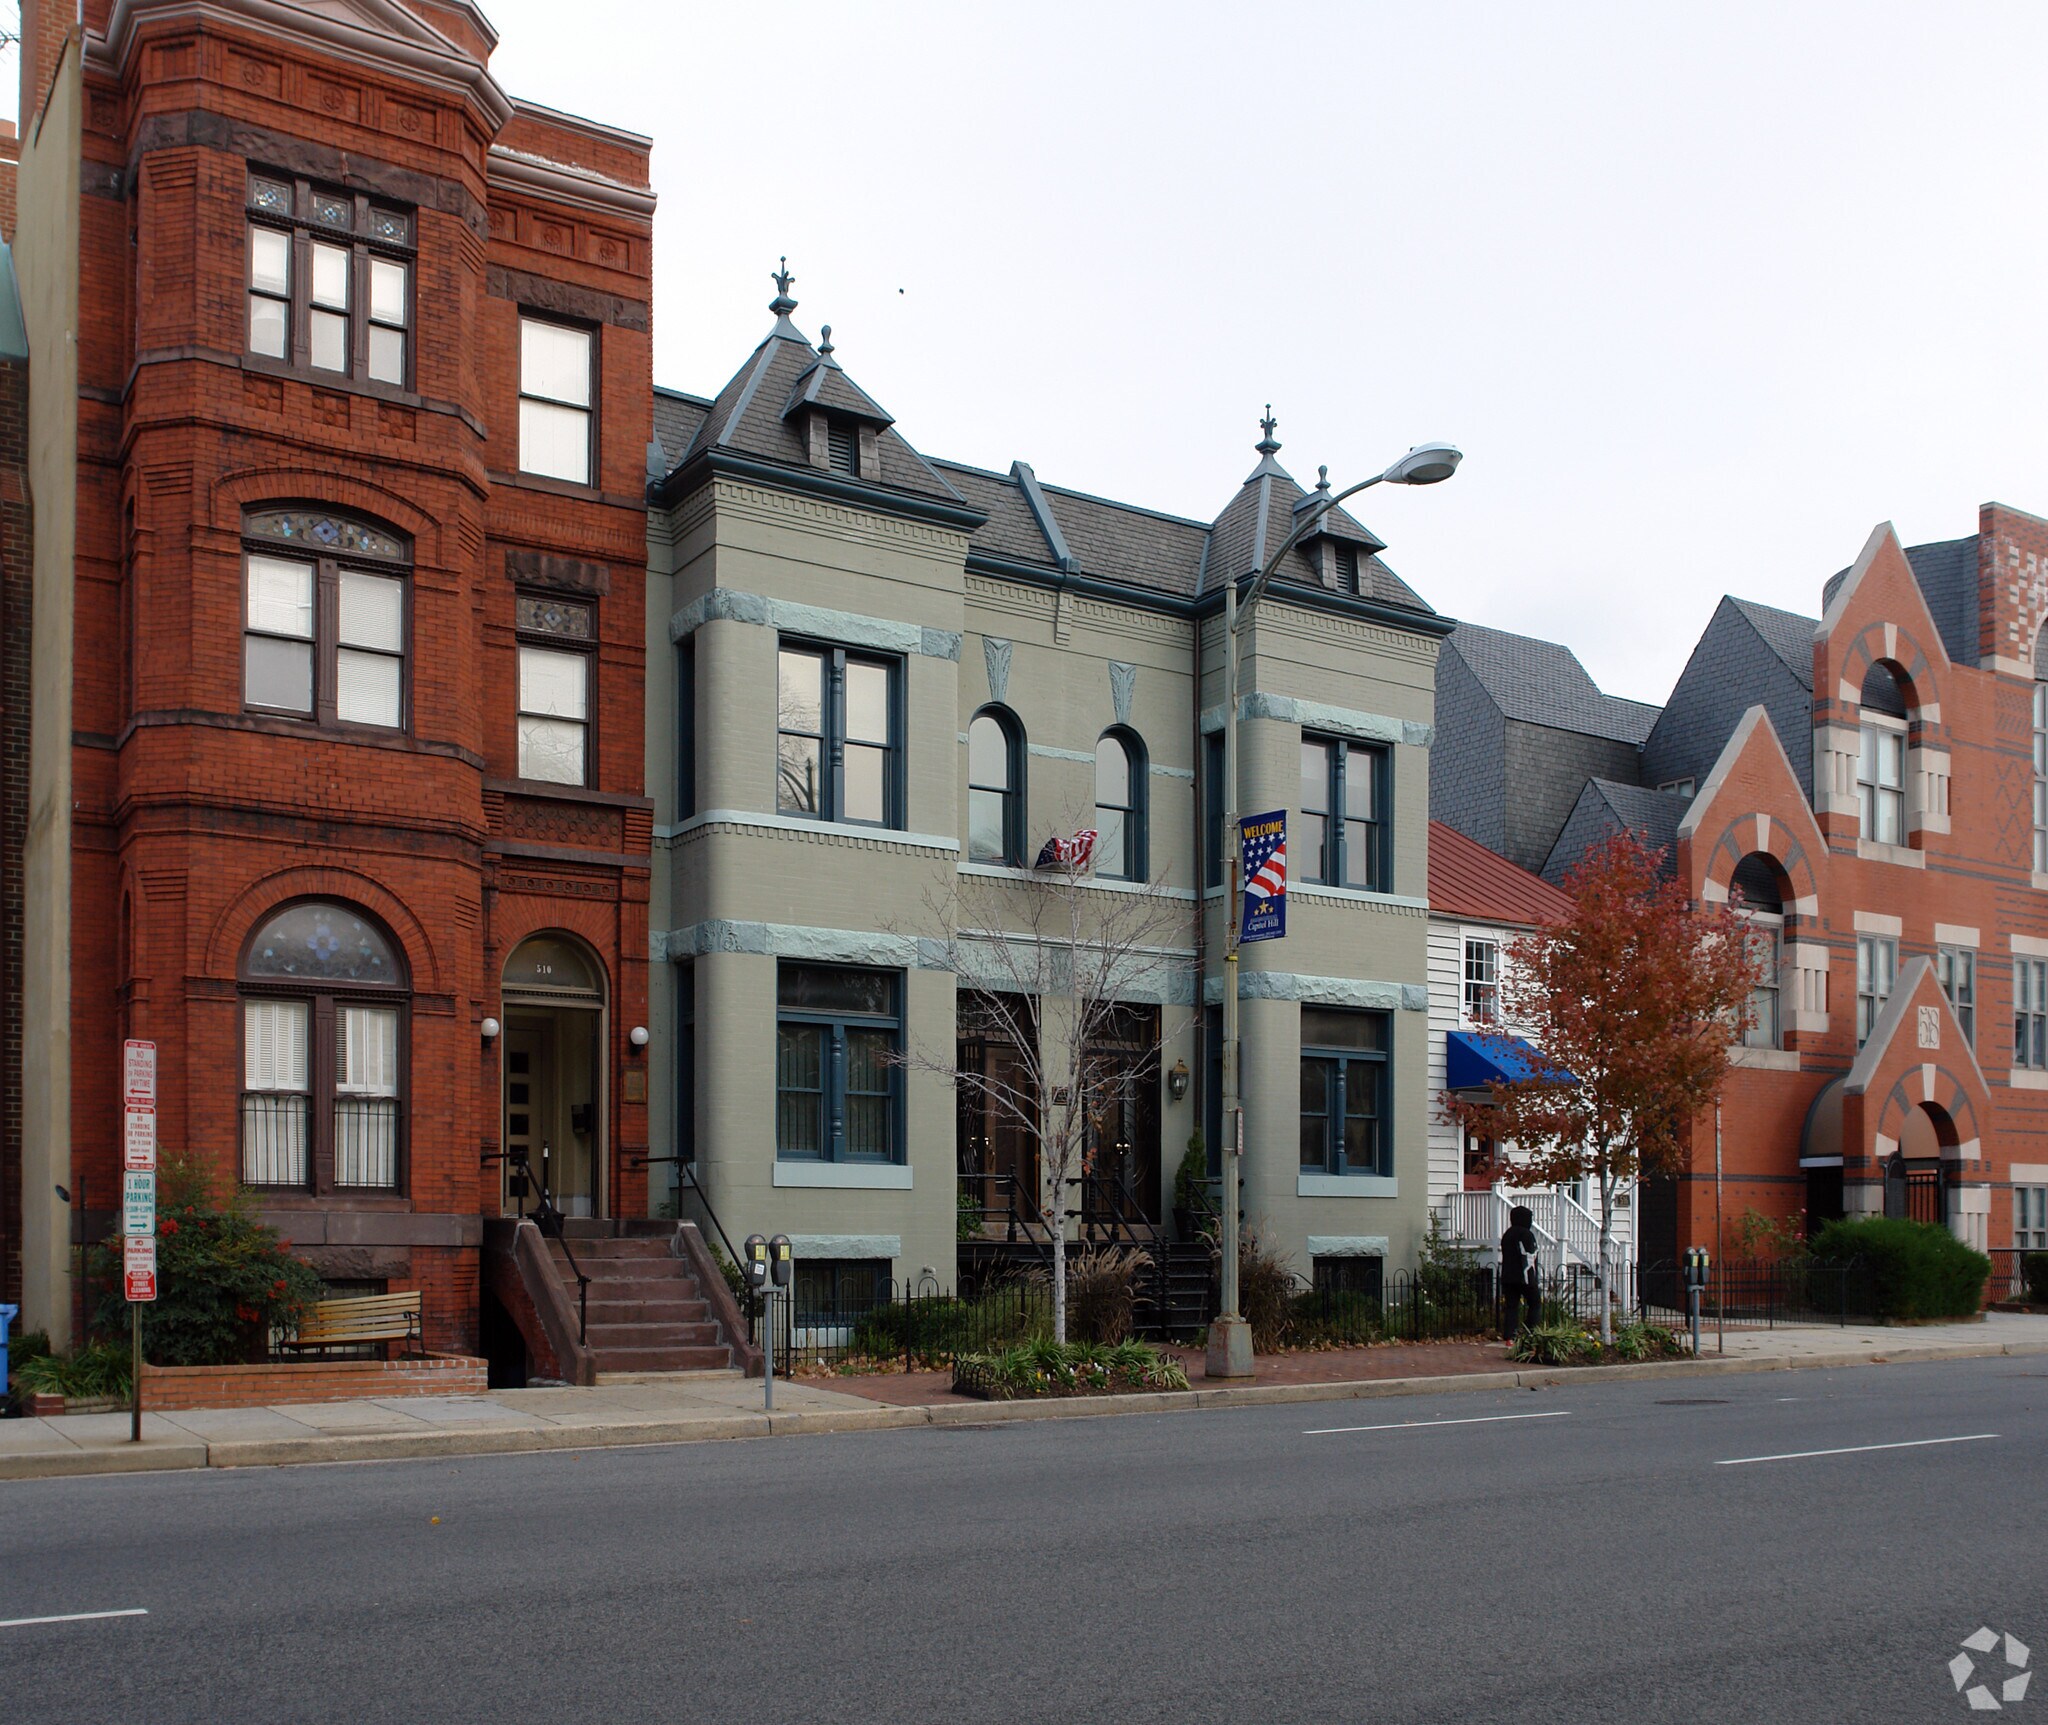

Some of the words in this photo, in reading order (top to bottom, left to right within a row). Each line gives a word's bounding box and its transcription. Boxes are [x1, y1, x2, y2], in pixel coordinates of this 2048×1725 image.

[1243, 820, 1284, 838] WELCOME
[1248, 920, 1267, 932] Capitol
[1268, 919, 1279, 927] Hill
[536, 964, 552, 974] 510
[136, 1050, 144, 1059] NO
[128, 1058, 152, 1069] STANDING
[134, 1069, 153, 1078] PARKING
[130, 1079, 150, 1088] ANYTIME
[134, 1130, 153, 1138] PARKING
[127, 1178, 132, 1190] 1
[133, 1178, 150, 1190] HOUR
[126, 1192, 152, 1203] PARKING
